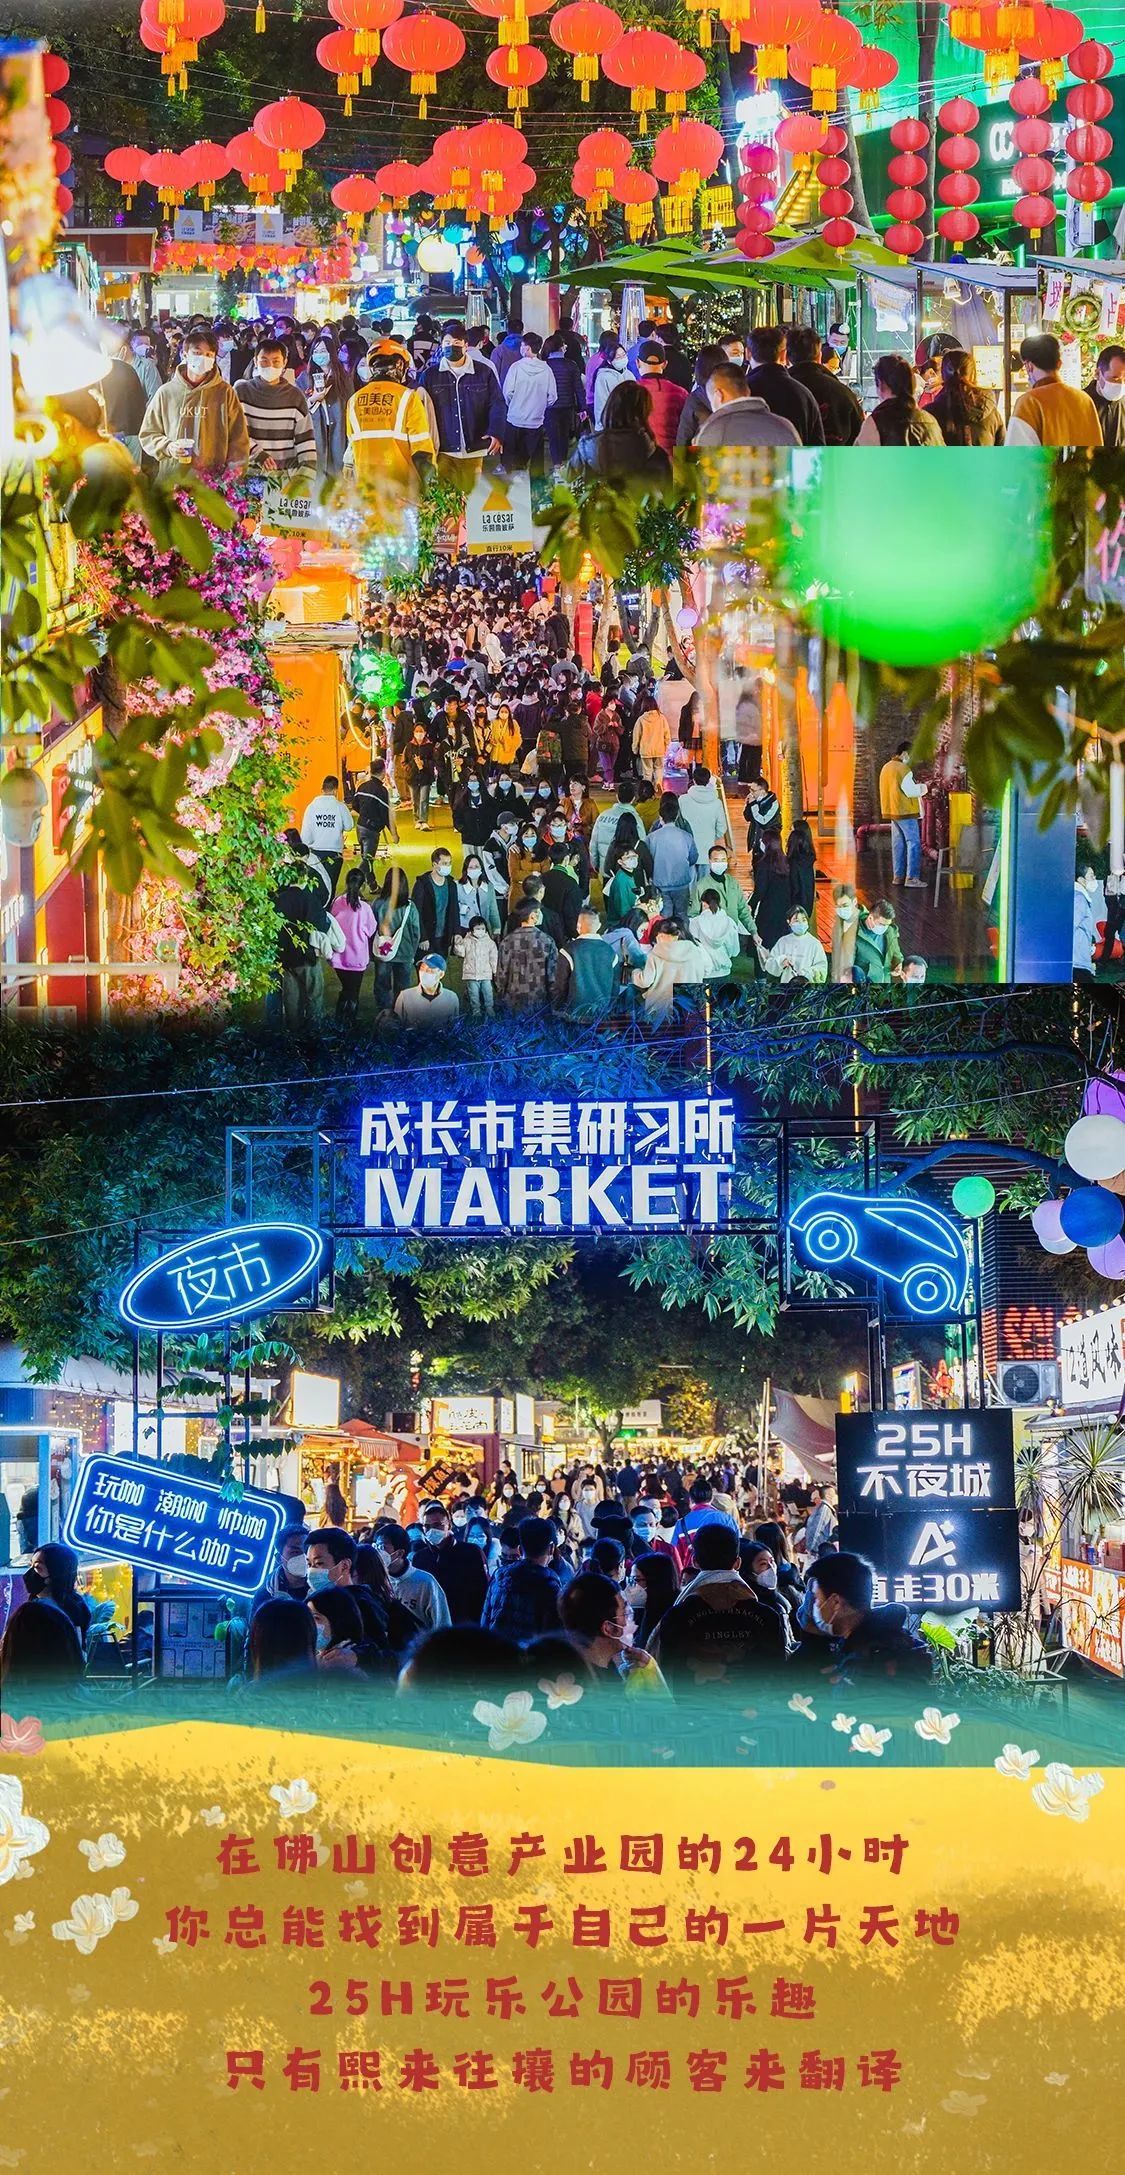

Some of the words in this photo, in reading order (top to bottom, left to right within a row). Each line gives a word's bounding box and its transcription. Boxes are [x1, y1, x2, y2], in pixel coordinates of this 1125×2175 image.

[360, 1098, 735, 1156] 成长市集研习所
[364, 1164, 735, 1227] MARKET
[166, 1242, 271, 1316] 夜市
[877, 1423, 971, 1457] 25H
[92, 1472, 146, 1507] 玩咖
[154, 1488, 208, 1524] 潮咖
[217, 1507, 267, 1540] 帅咖
[857, 1463, 991, 1500] 不夜城
[872, 1573, 1000, 1603] 直走30米
